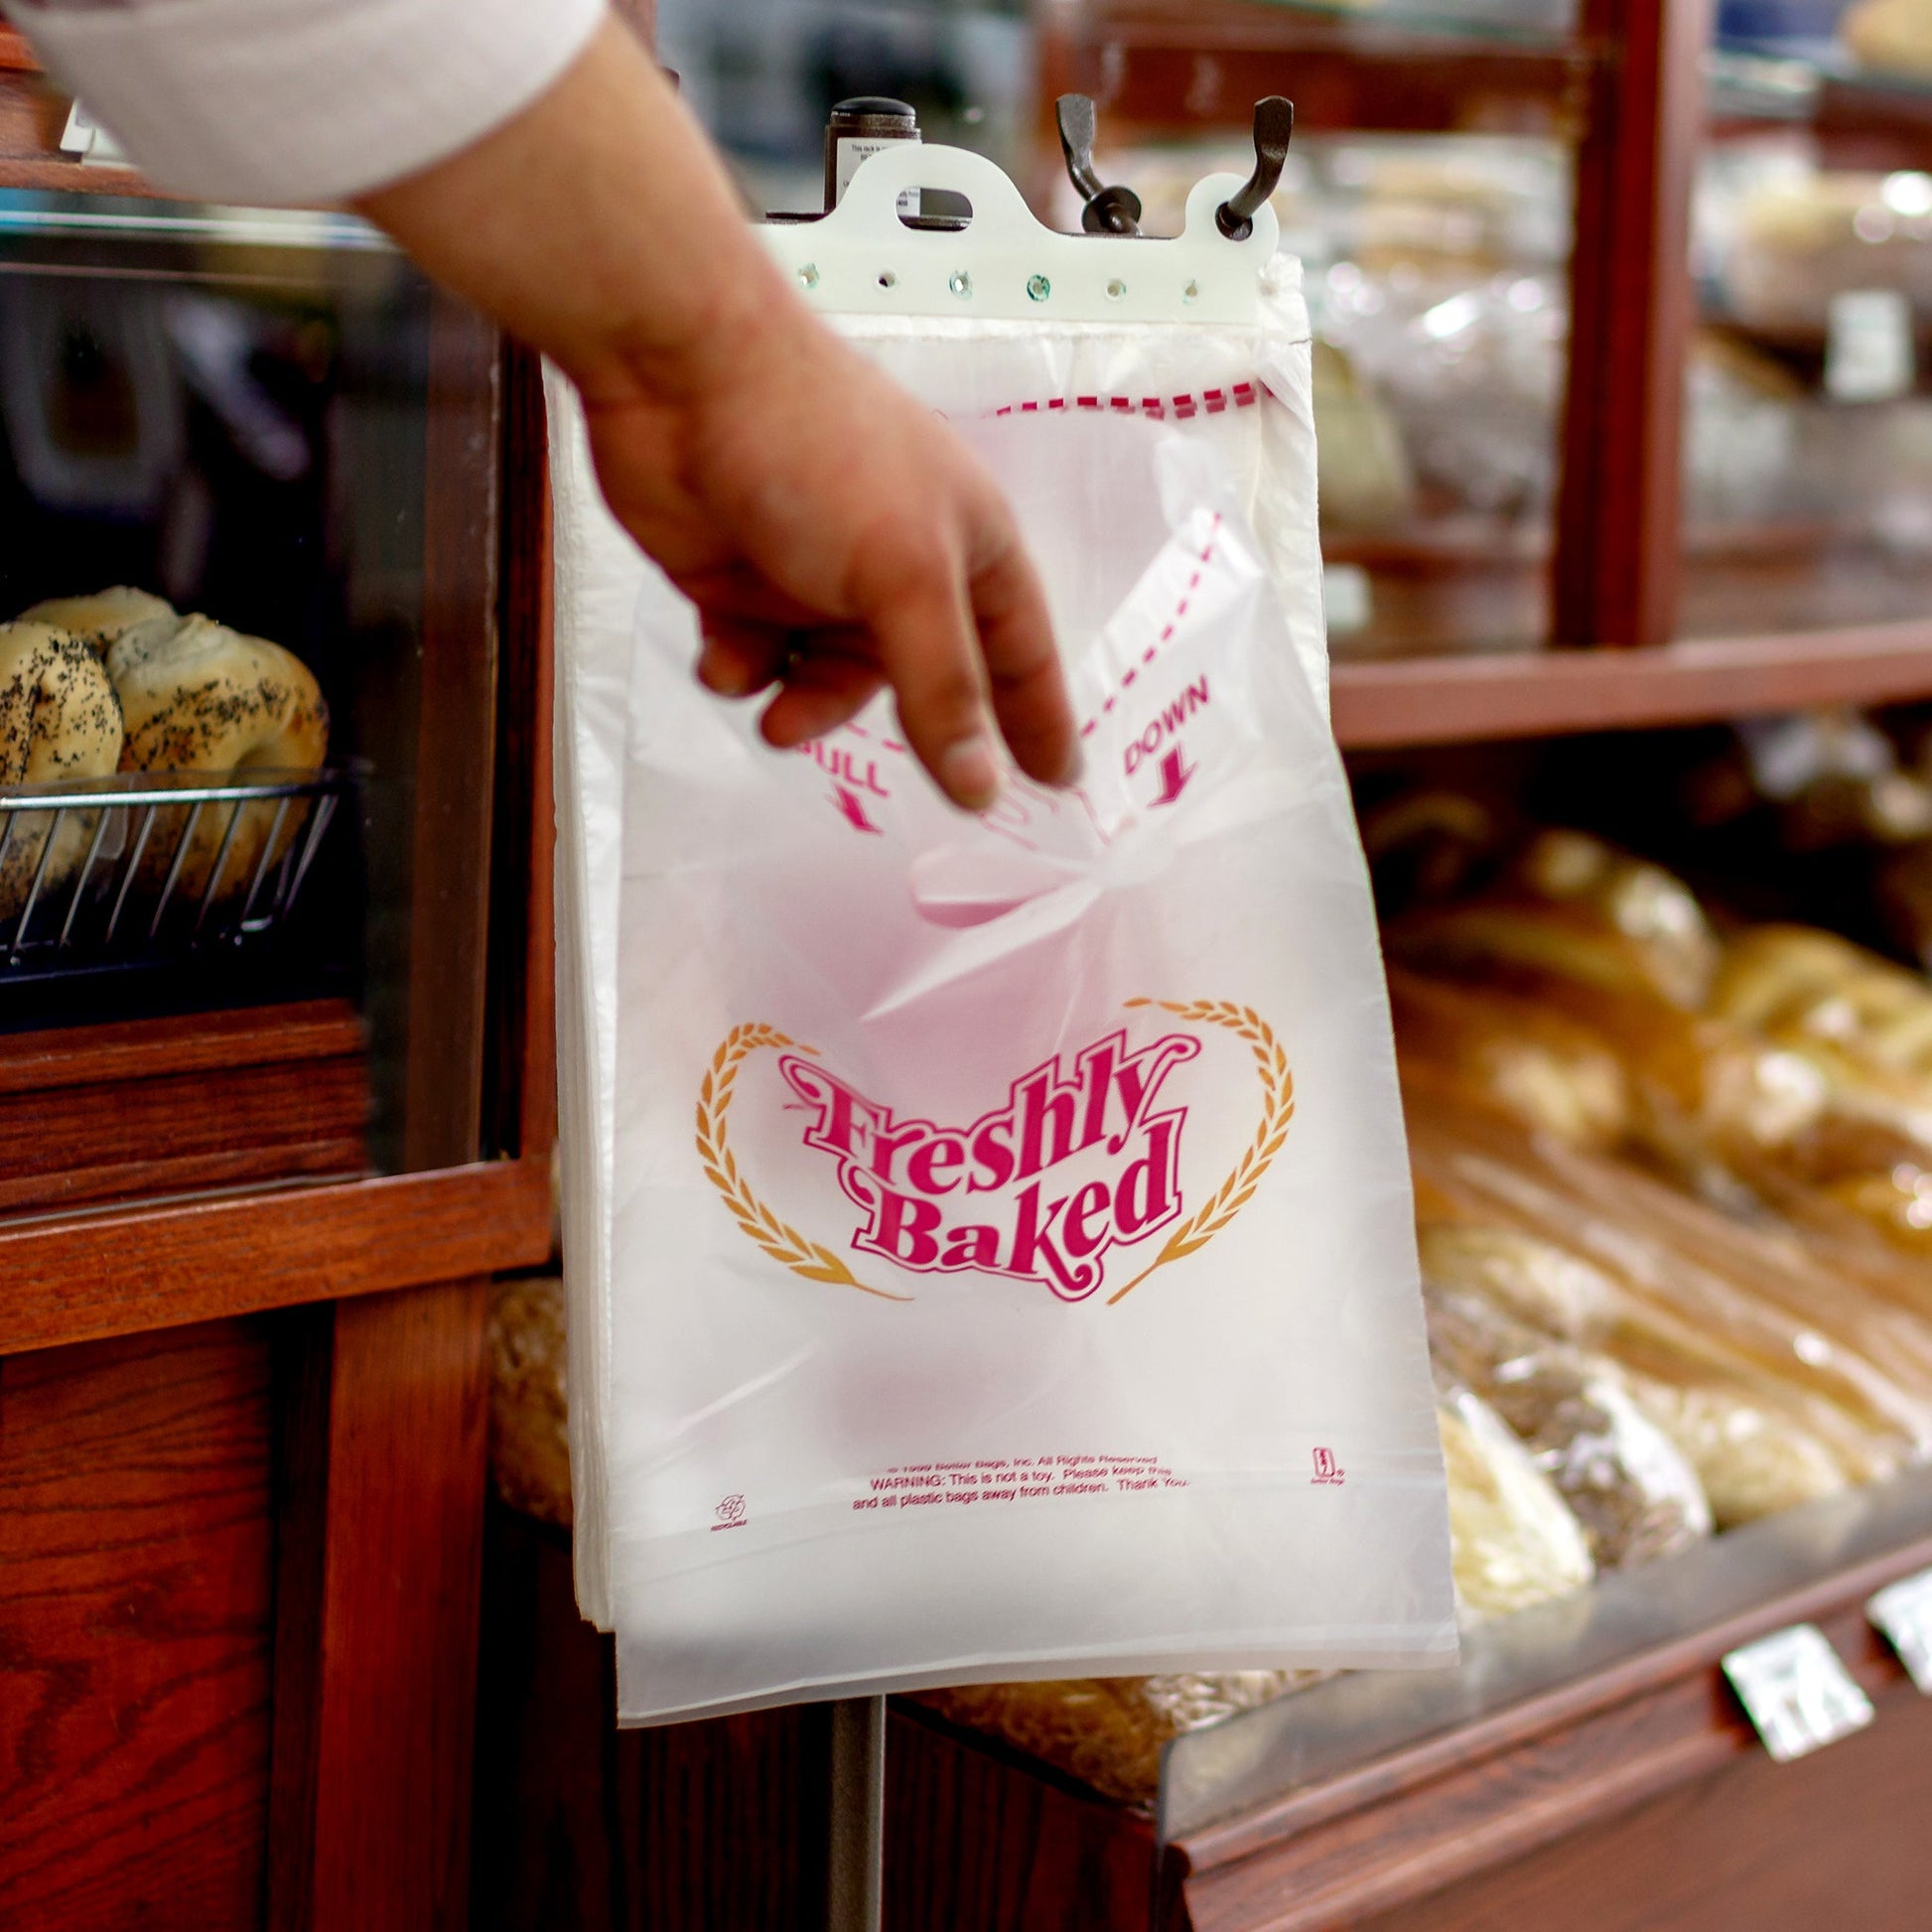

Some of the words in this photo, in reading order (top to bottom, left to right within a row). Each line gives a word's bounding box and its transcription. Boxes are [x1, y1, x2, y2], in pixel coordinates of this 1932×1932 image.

[1124, 673, 1210, 776] DOWN
[778, 1028, 1201, 1194] Freshly
[837, 1106, 1188, 1303] Baked
[852, 1496, 878, 1510] and
[882, 1494, 897, 1508] all
[900, 1491, 942, 1509] plastic
[945, 1489, 979, 1505] bags
[981, 1487, 1017, 1502] away
[1020, 1485, 1050, 1497] from
[1052, 1482, 1110, 1496] children.
[1117, 1478, 1159, 1491] Thank
[870, 1474, 946, 1491] WARNING:
[949, 1473, 977, 1486] This
[981, 1472, 993, 1484] is
[996, 1471, 1017, 1483] not
[1020, 1472, 1029, 1482] a
[1032, 1470, 1054, 1483] toy.
[1062, 1467, 1108, 1480] Please
[1112, 1465, 1145, 1476] keep
[1037, 1455, 1053, 1466] All
[1055, 1454, 1095, 1467] Rights
